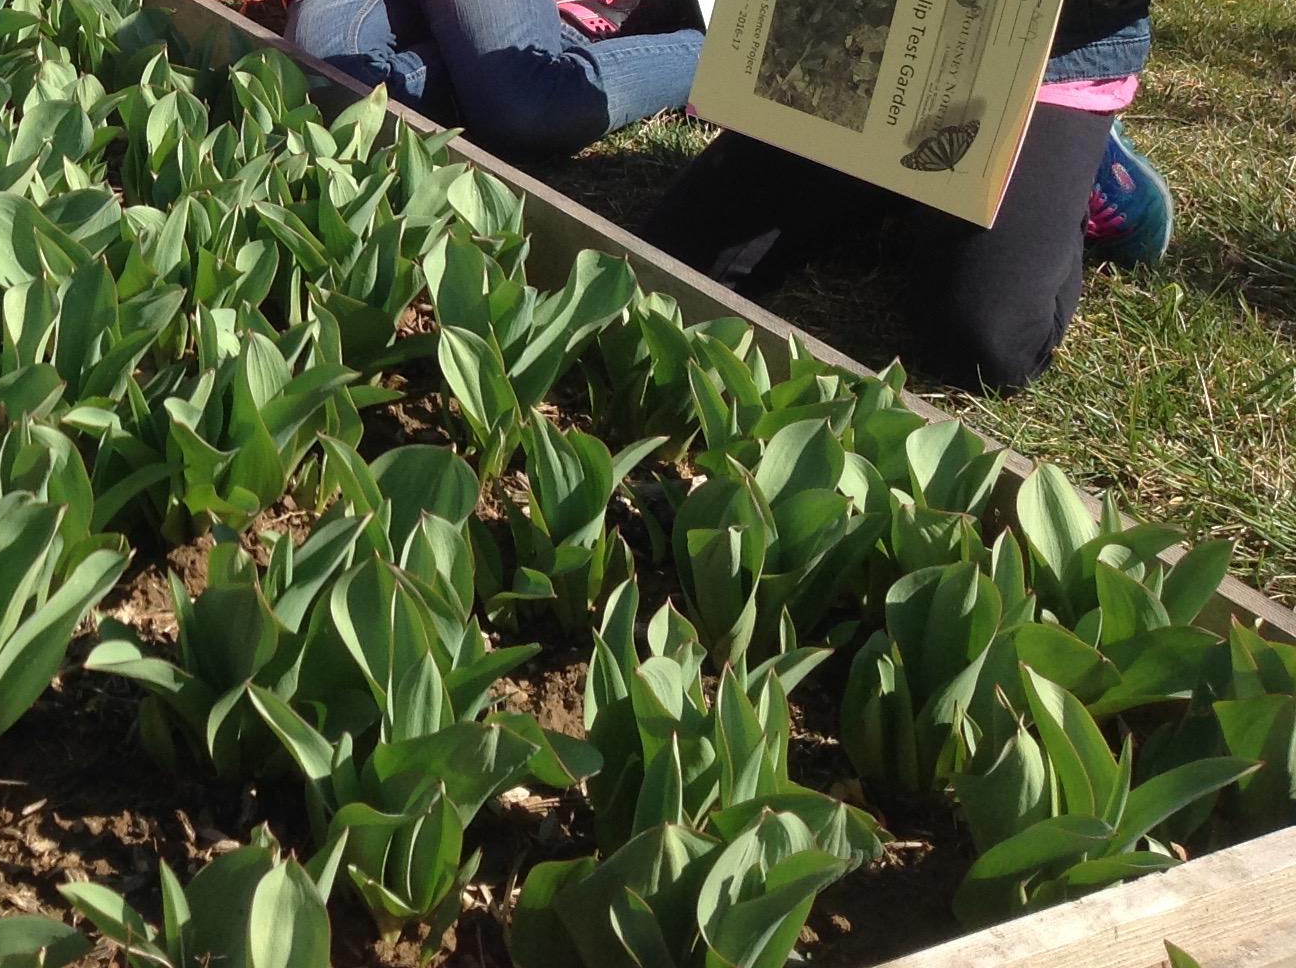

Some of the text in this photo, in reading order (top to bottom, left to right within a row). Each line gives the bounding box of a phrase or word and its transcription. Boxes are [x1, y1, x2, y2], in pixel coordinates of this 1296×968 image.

[732, 10, 747, 50] 2016-17
[752, 3, 769, 39] Science
[743, 40, 760, 75] Project
[903, 23, 926, 60] Test
[949, 12, 974, 75] JOURNEY
[885, 63, 916, 127] Garden
